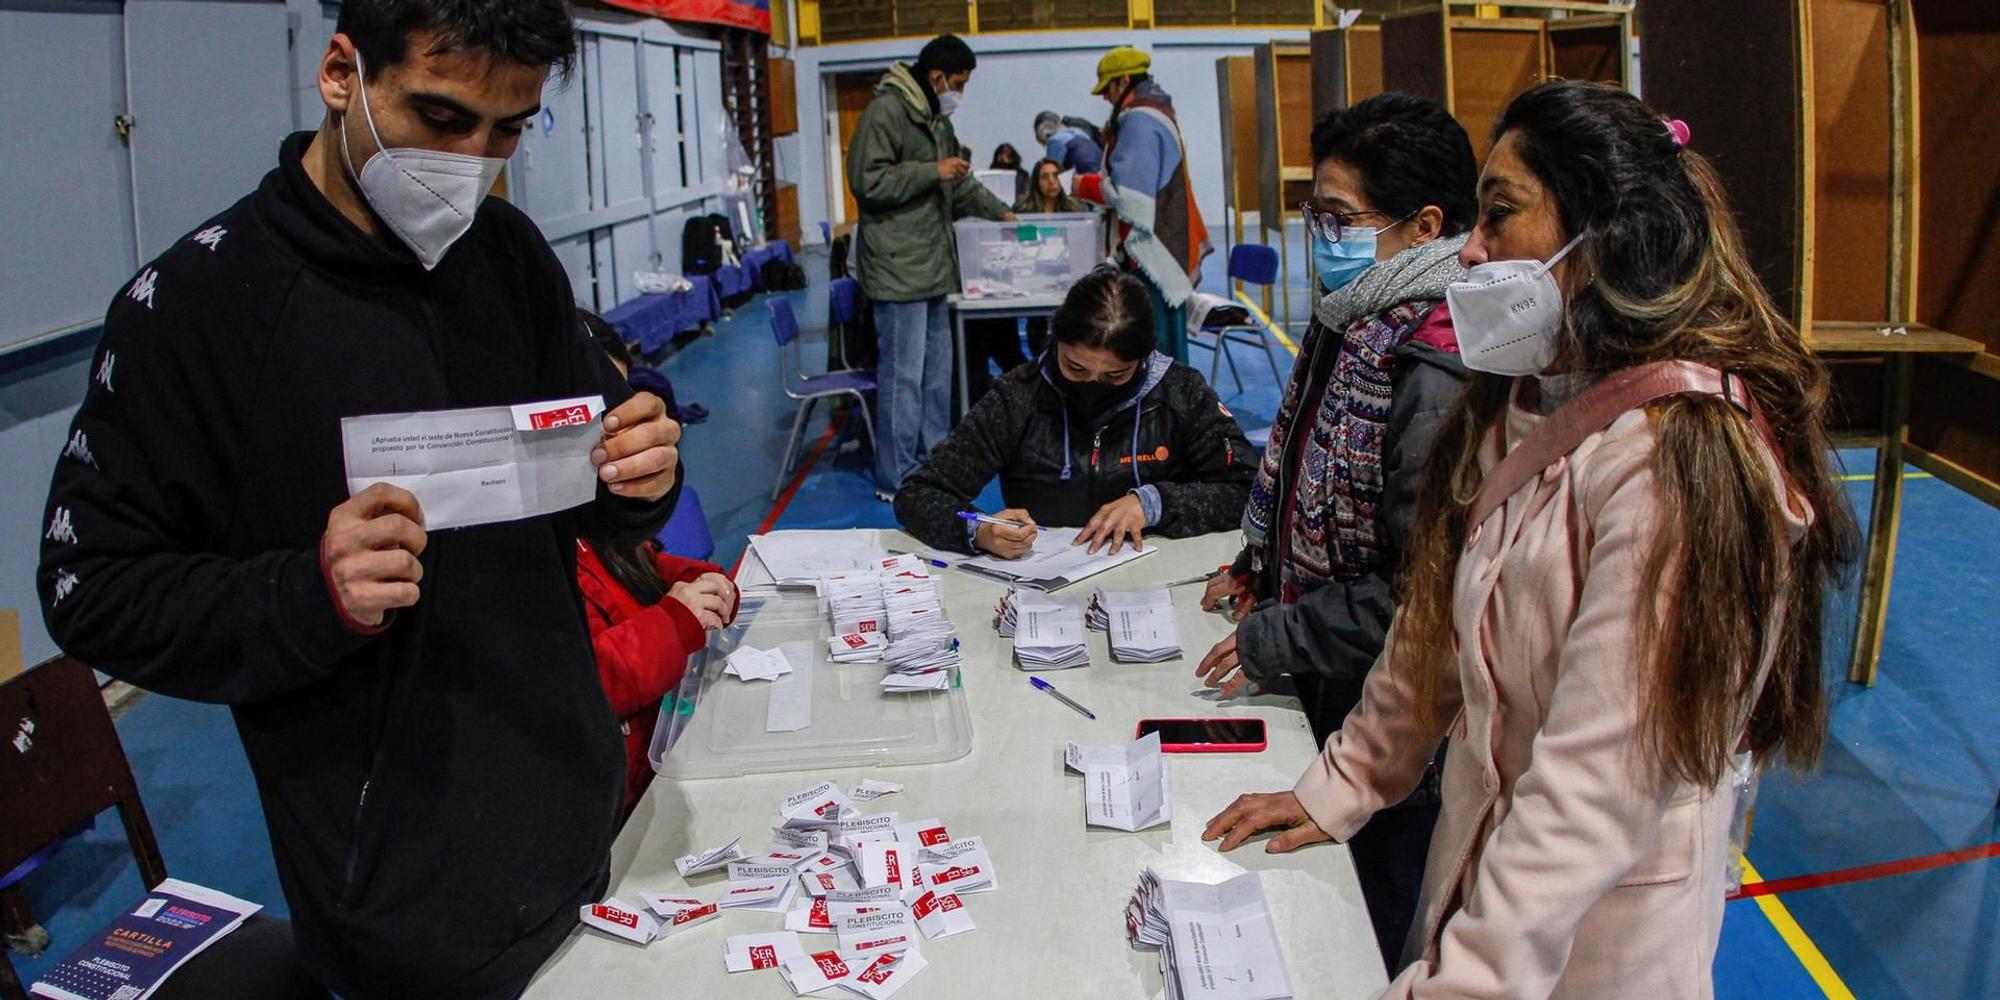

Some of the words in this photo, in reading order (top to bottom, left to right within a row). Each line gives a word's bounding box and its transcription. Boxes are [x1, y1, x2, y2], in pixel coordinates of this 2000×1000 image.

[1510, 297, 1536, 314] KN95
[566, 408, 587, 425] SE
[372, 435, 402, 446] ¿Aprueba
[402, 434, 420, 443] usted
[421, 434, 427, 442] el
[428, 433, 444, 442] texto
[445, 432, 453, 440] de
[454, 430, 474, 440] Nueva
[475, 426, 514, 437] Constitución
[372, 444, 403, 454] propuesto
[405, 444, 417, 452] por
[418, 442, 425, 450] la
[426, 440, 464, 450] Convención
[1119, 453, 1156, 464] MERELL
[481, 479, 507, 488] Rechazo
[787, 784, 830, 803] PLEBISCITO
[840, 817, 891, 827] PLEBISCITO
[737, 866, 790, 874] PLEBISCITO
[847, 912, 904, 924] PLEBISCITO
[847, 919, 904, 929] CONSTITUCIONAL
[112, 928, 173, 950] CARTILLA
[752, 948, 773, 960] SER
[92, 956, 131, 972] PLEBISCITO
[826, 962, 848, 976] SER
